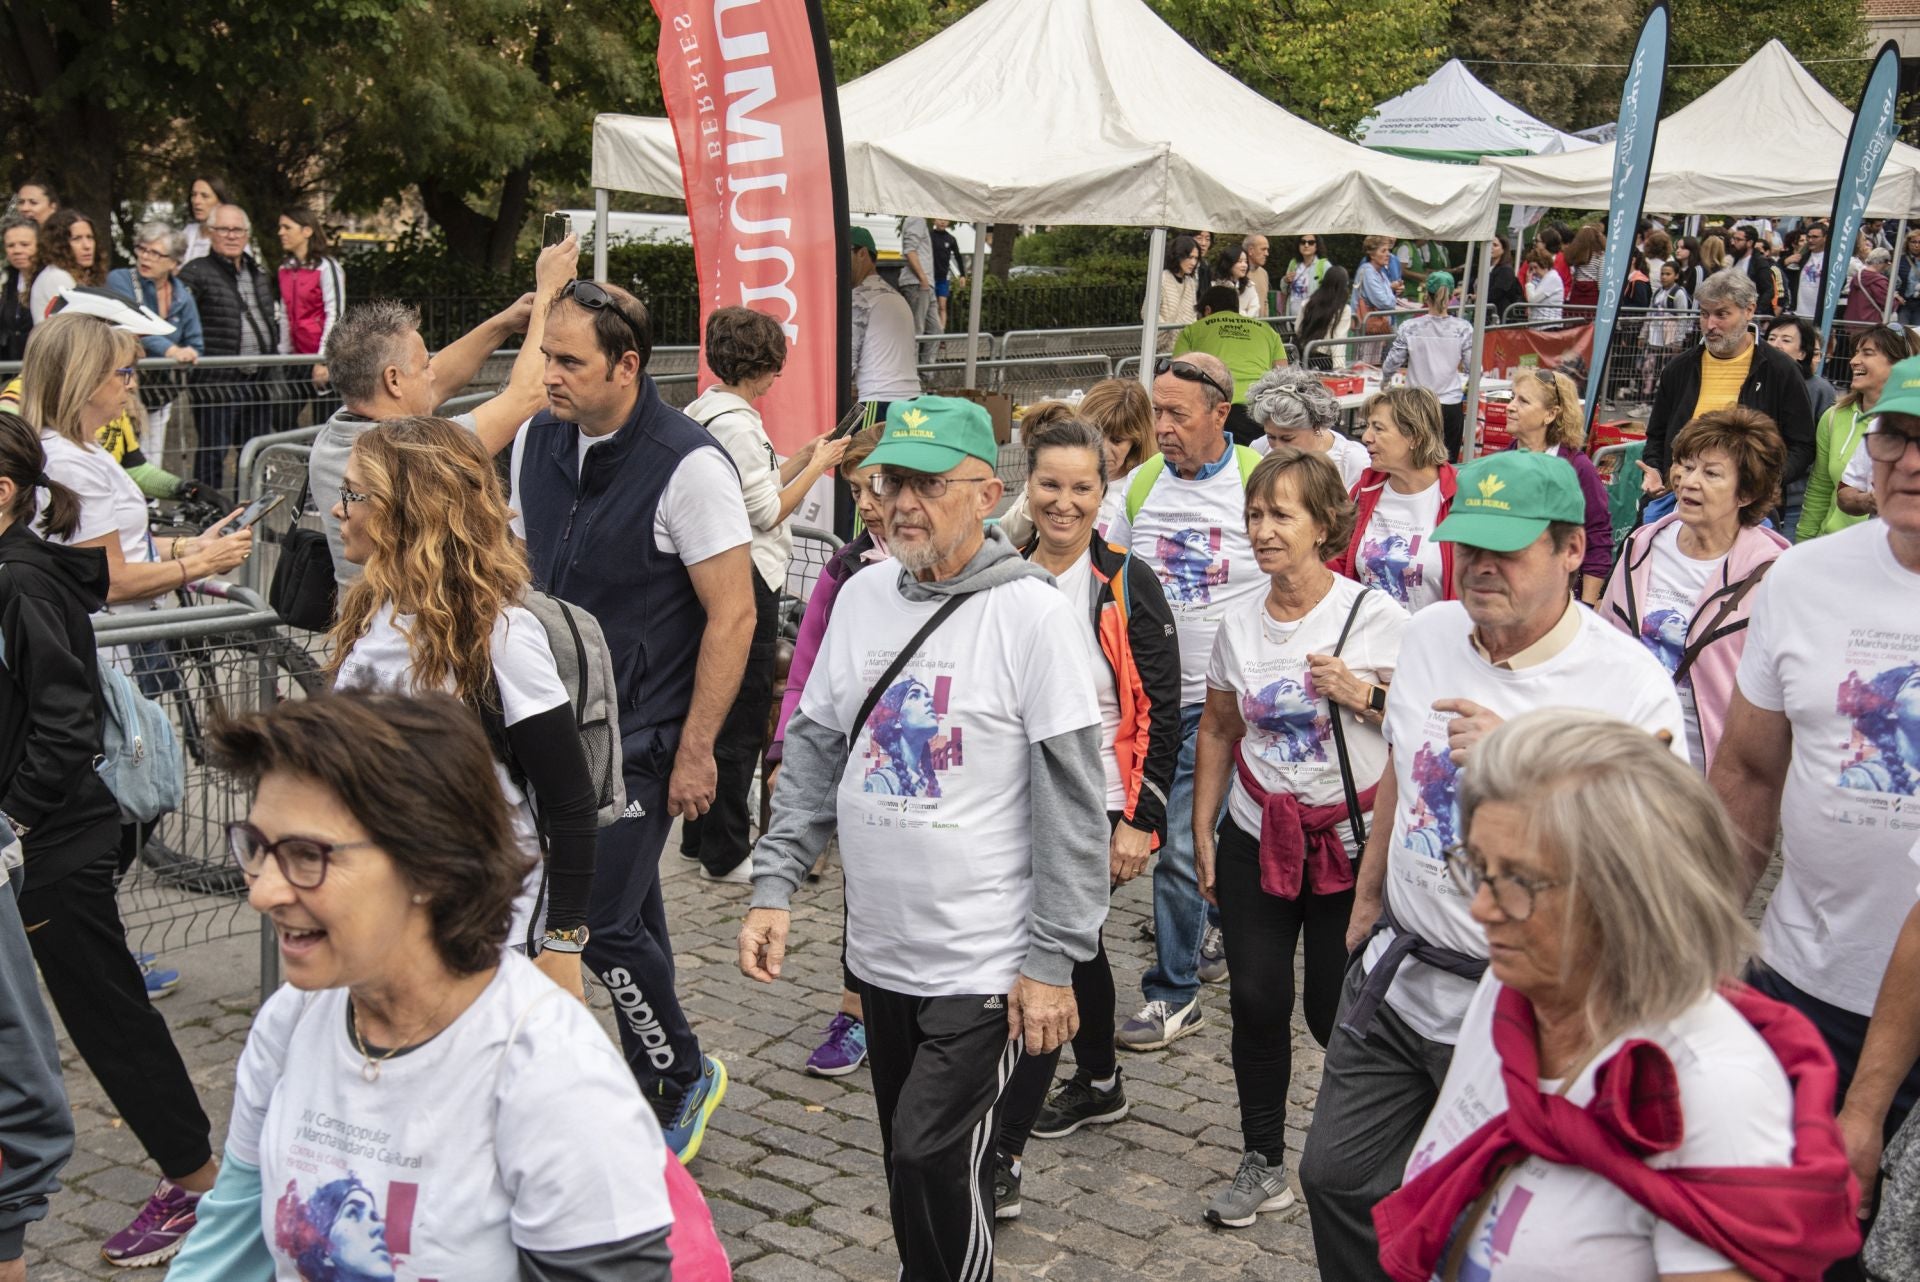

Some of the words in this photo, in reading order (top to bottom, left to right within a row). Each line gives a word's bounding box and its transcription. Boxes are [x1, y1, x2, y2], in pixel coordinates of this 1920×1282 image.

[920, 660, 936, 670] Caja
[937, 661, 956, 669] Rural
[601, 966, 676, 1071] adidas
